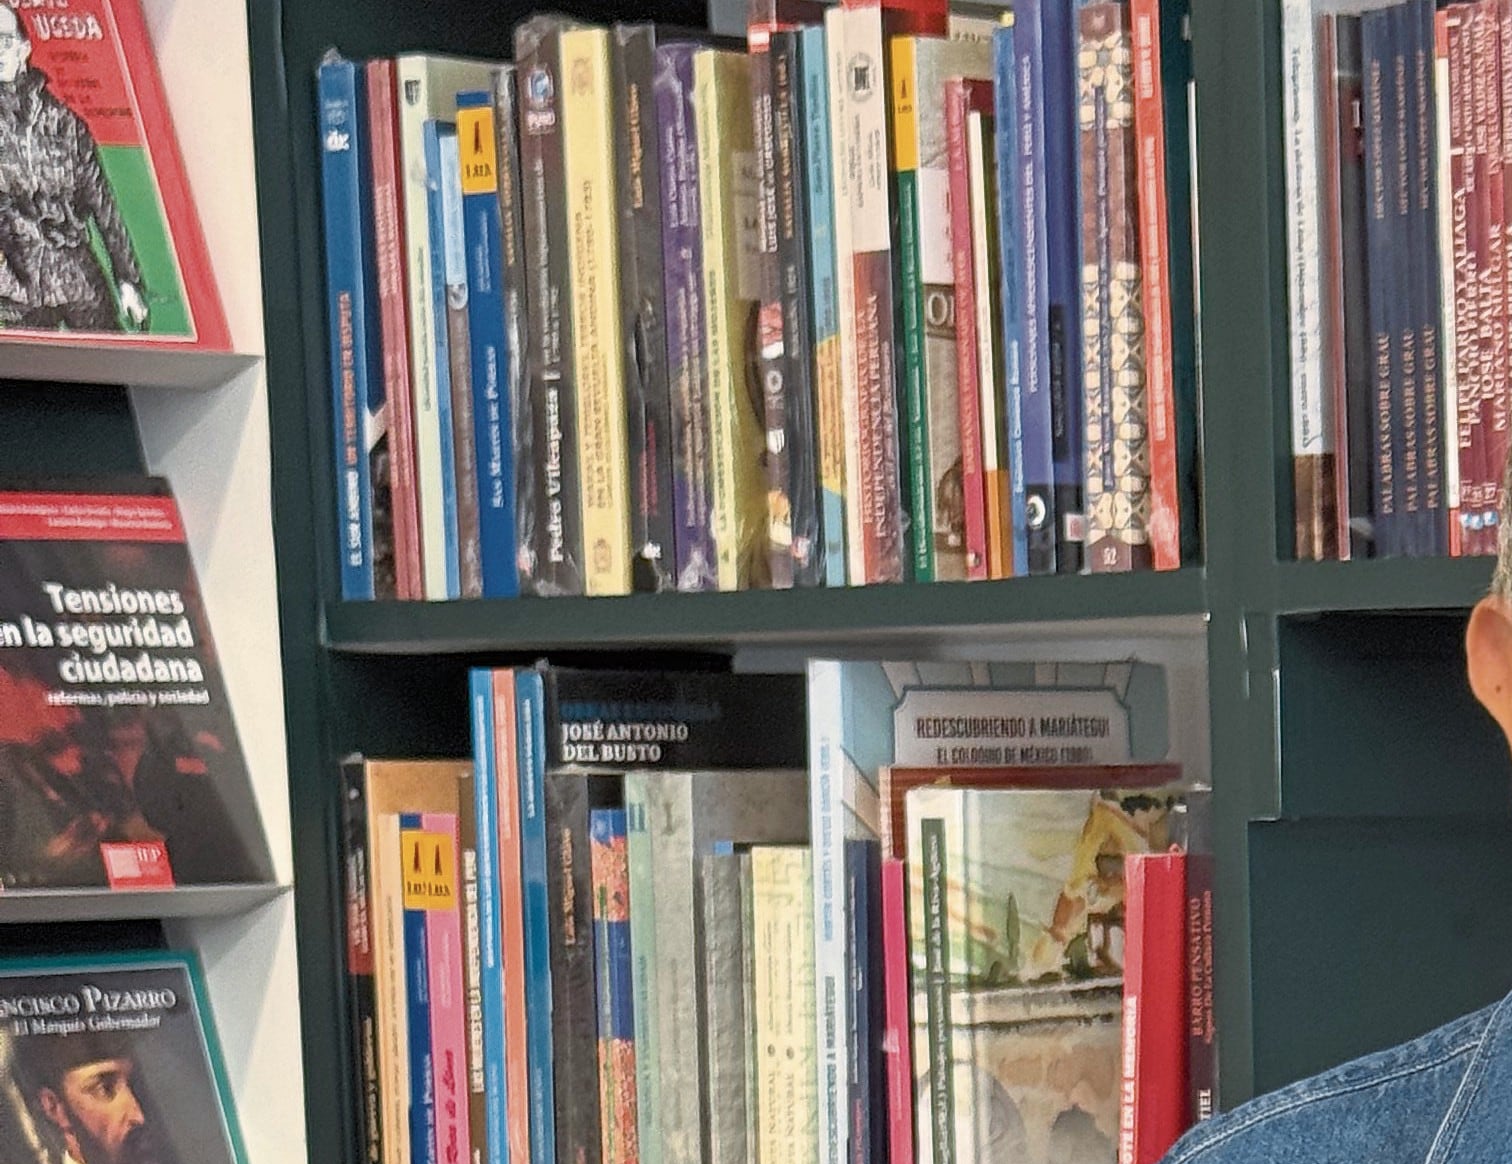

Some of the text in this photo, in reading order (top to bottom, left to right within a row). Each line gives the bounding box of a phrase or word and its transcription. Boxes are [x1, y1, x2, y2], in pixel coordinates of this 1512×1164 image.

[1454, 188, 1468, 270] ALIAGA
[1477, 267, 1492, 337] BALTA
[1456, 297, 1470, 372] PARDO
[1377, 332, 1395, 514] PALABRAS SOBRE GRAU
[1403, 379, 1417, 428] SOBRE
[1424, 372, 1437, 424] SOBRE
[1457, 376, 1472, 448] FELIPE
[1404, 430, 1419, 512] PALABRAS
[1425, 427, 1439, 509] PALABRAS
[546, 499, 564, 562] Pedro
[42, 581, 184, 614] Tensiones
[21, 614, 195, 654] la seguridad
[59, 651, 204, 683] ciudadana
[561, 719, 689, 741] JOSÉ ANTONIO
[562, 743, 662, 763] DEL BUSTO
[916, 713, 1110, 740] REDESCUBRIENDO A MARIÁTEGUI
[1191, 898, 1203, 1036] BARRO PENSATIVO
[0, 985, 177, 1018] NCISCO PIZARRO
[1121, 996, 1139, 1128] EN LA MEMORIA
